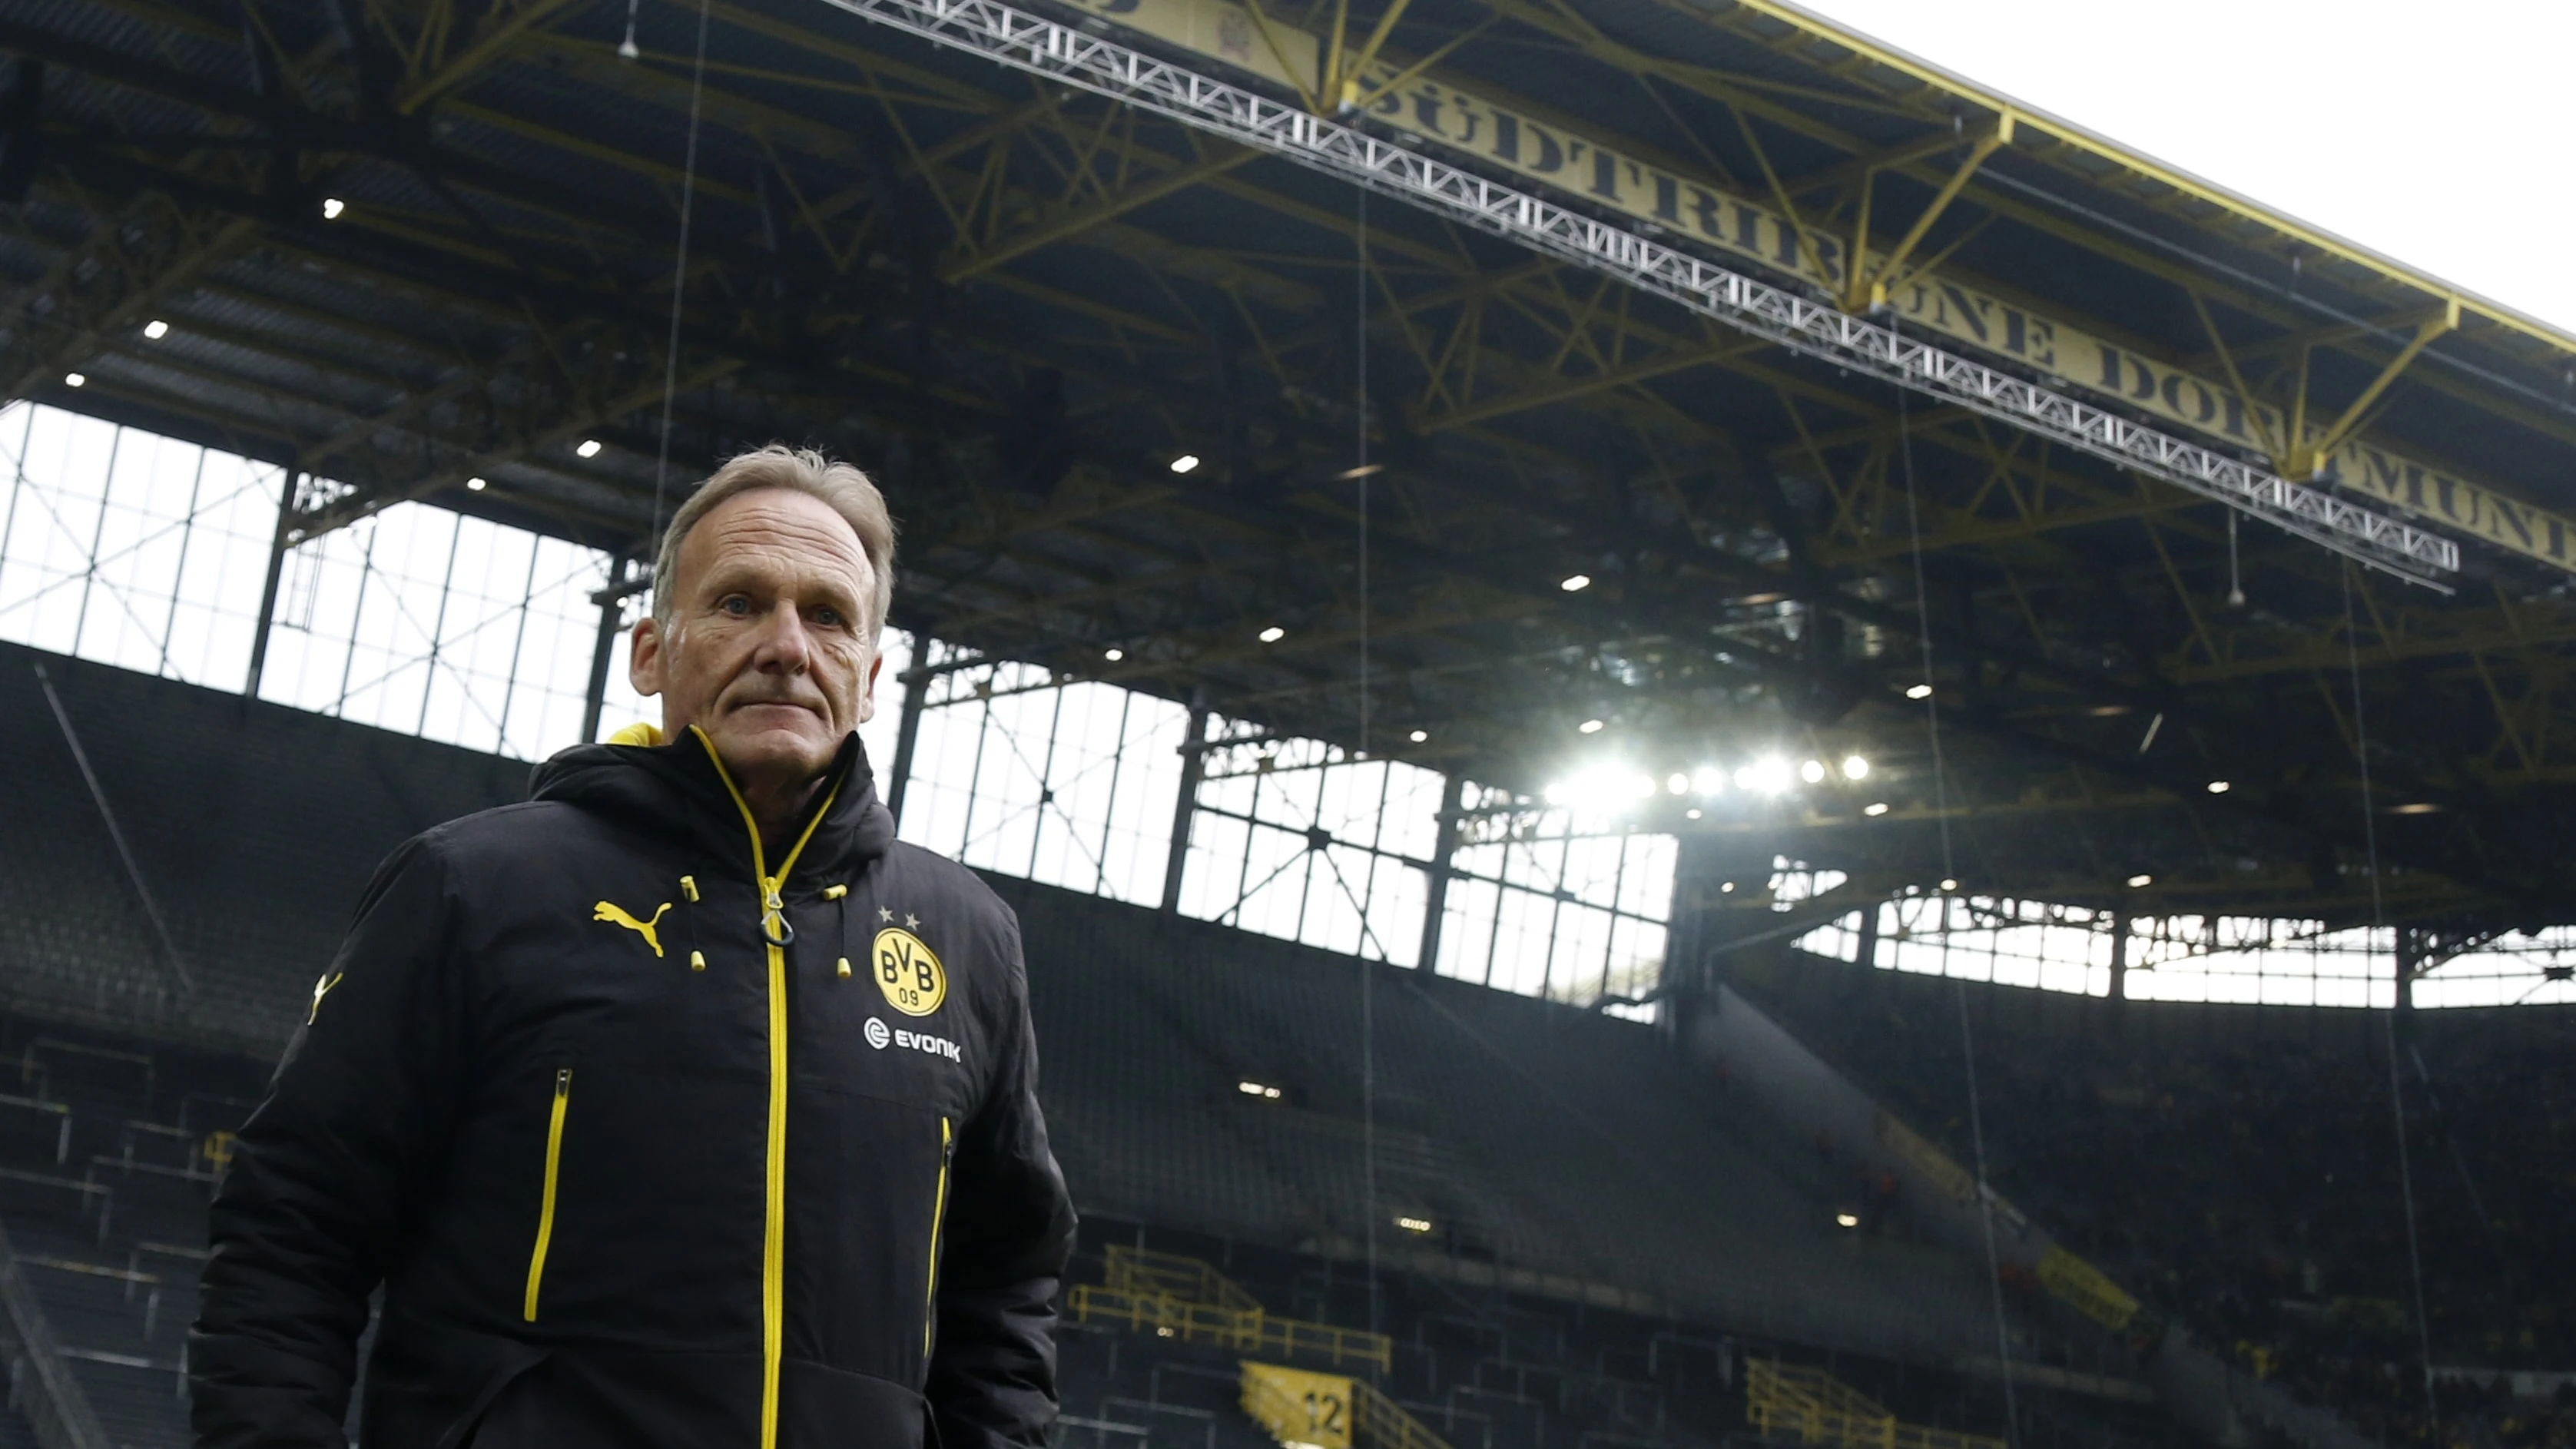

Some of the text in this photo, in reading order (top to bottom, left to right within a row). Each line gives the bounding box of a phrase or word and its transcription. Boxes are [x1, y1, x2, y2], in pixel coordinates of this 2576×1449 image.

[880, 937, 934, 993] BVB
[898, 987, 920, 1006] 09
[894, 1028, 962, 1063] EVONIK
[1303, 1391, 1344, 1435] 12
